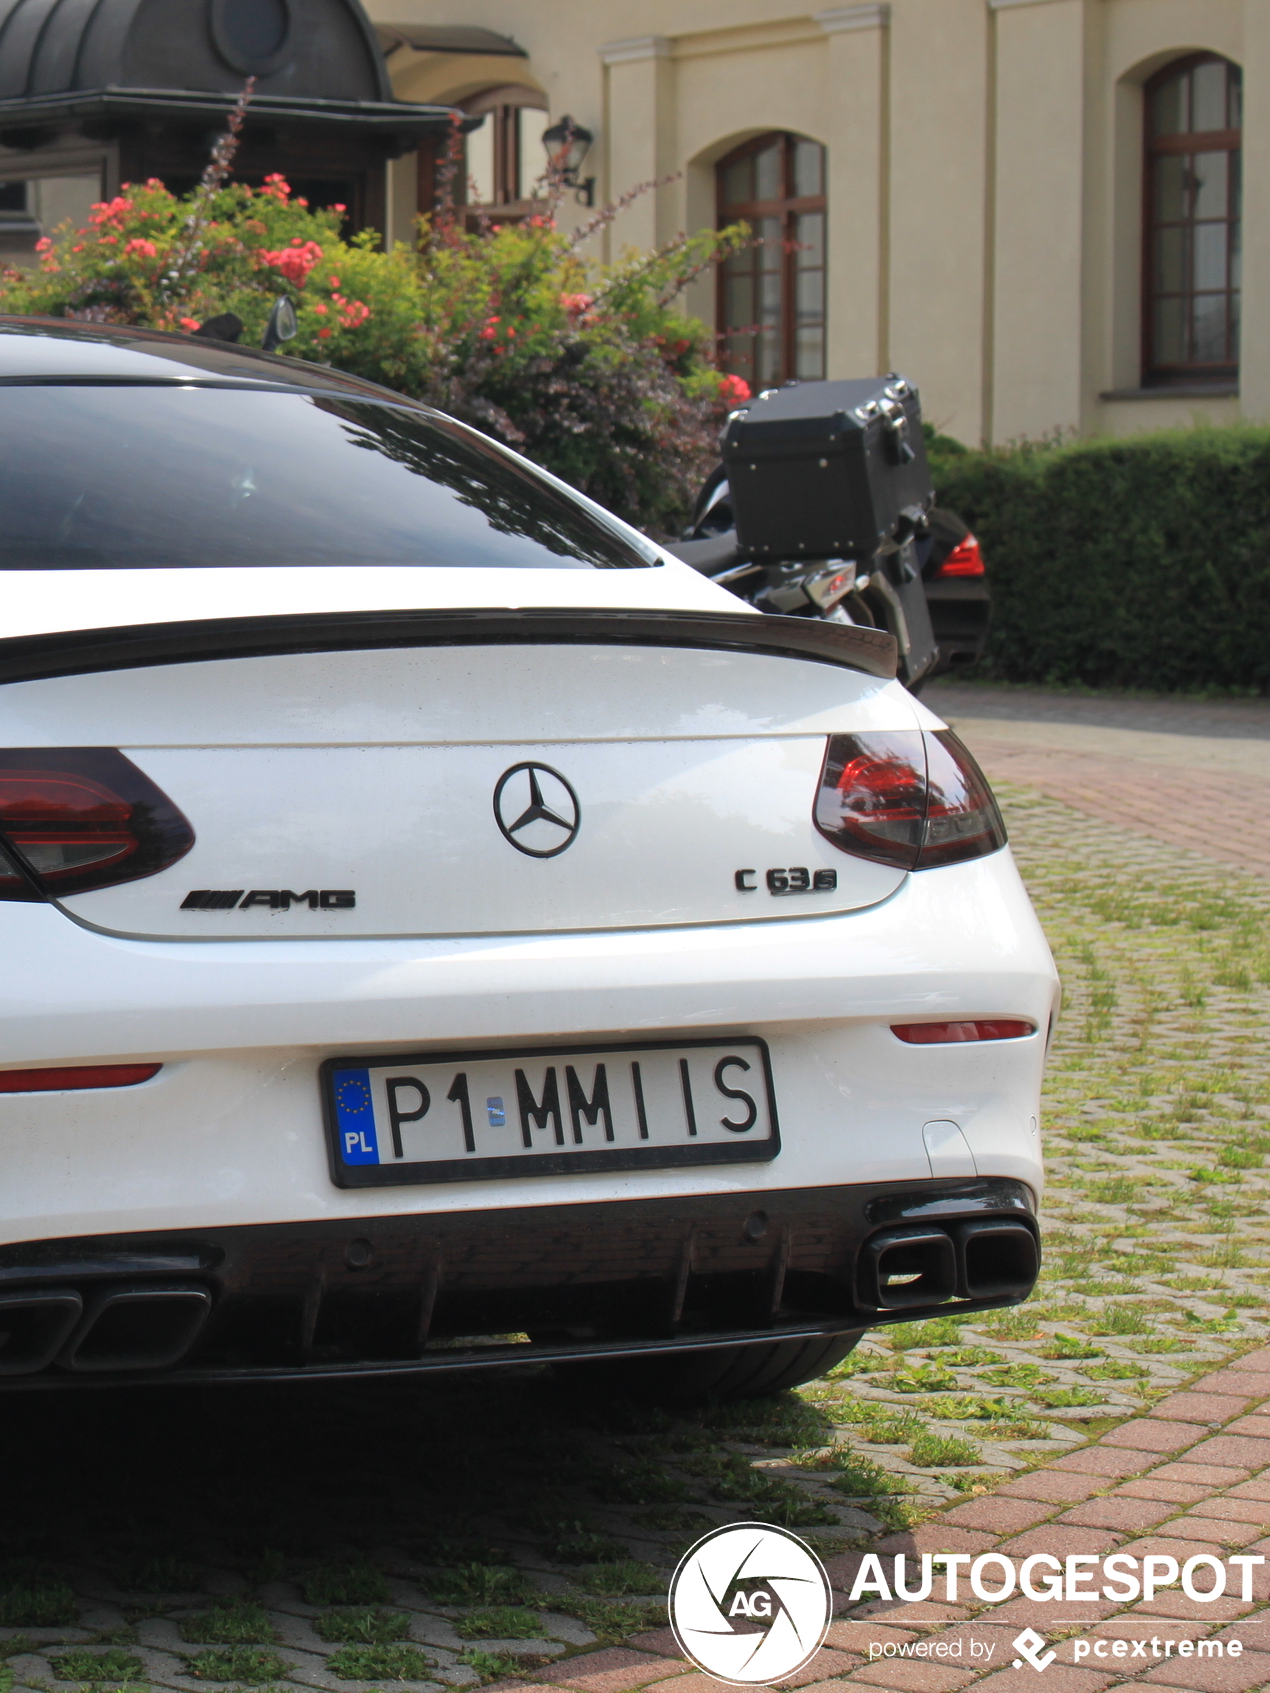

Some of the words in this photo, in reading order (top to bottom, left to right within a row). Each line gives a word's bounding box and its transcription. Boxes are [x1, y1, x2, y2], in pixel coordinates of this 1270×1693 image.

[735, 868, 758, 892] C
[238, 890, 356, 909] AMG
[385, 1072, 477, 1159] P1
[514, 1055, 758, 1148] MMIIS
[344, 1131, 373, 1155] PL
